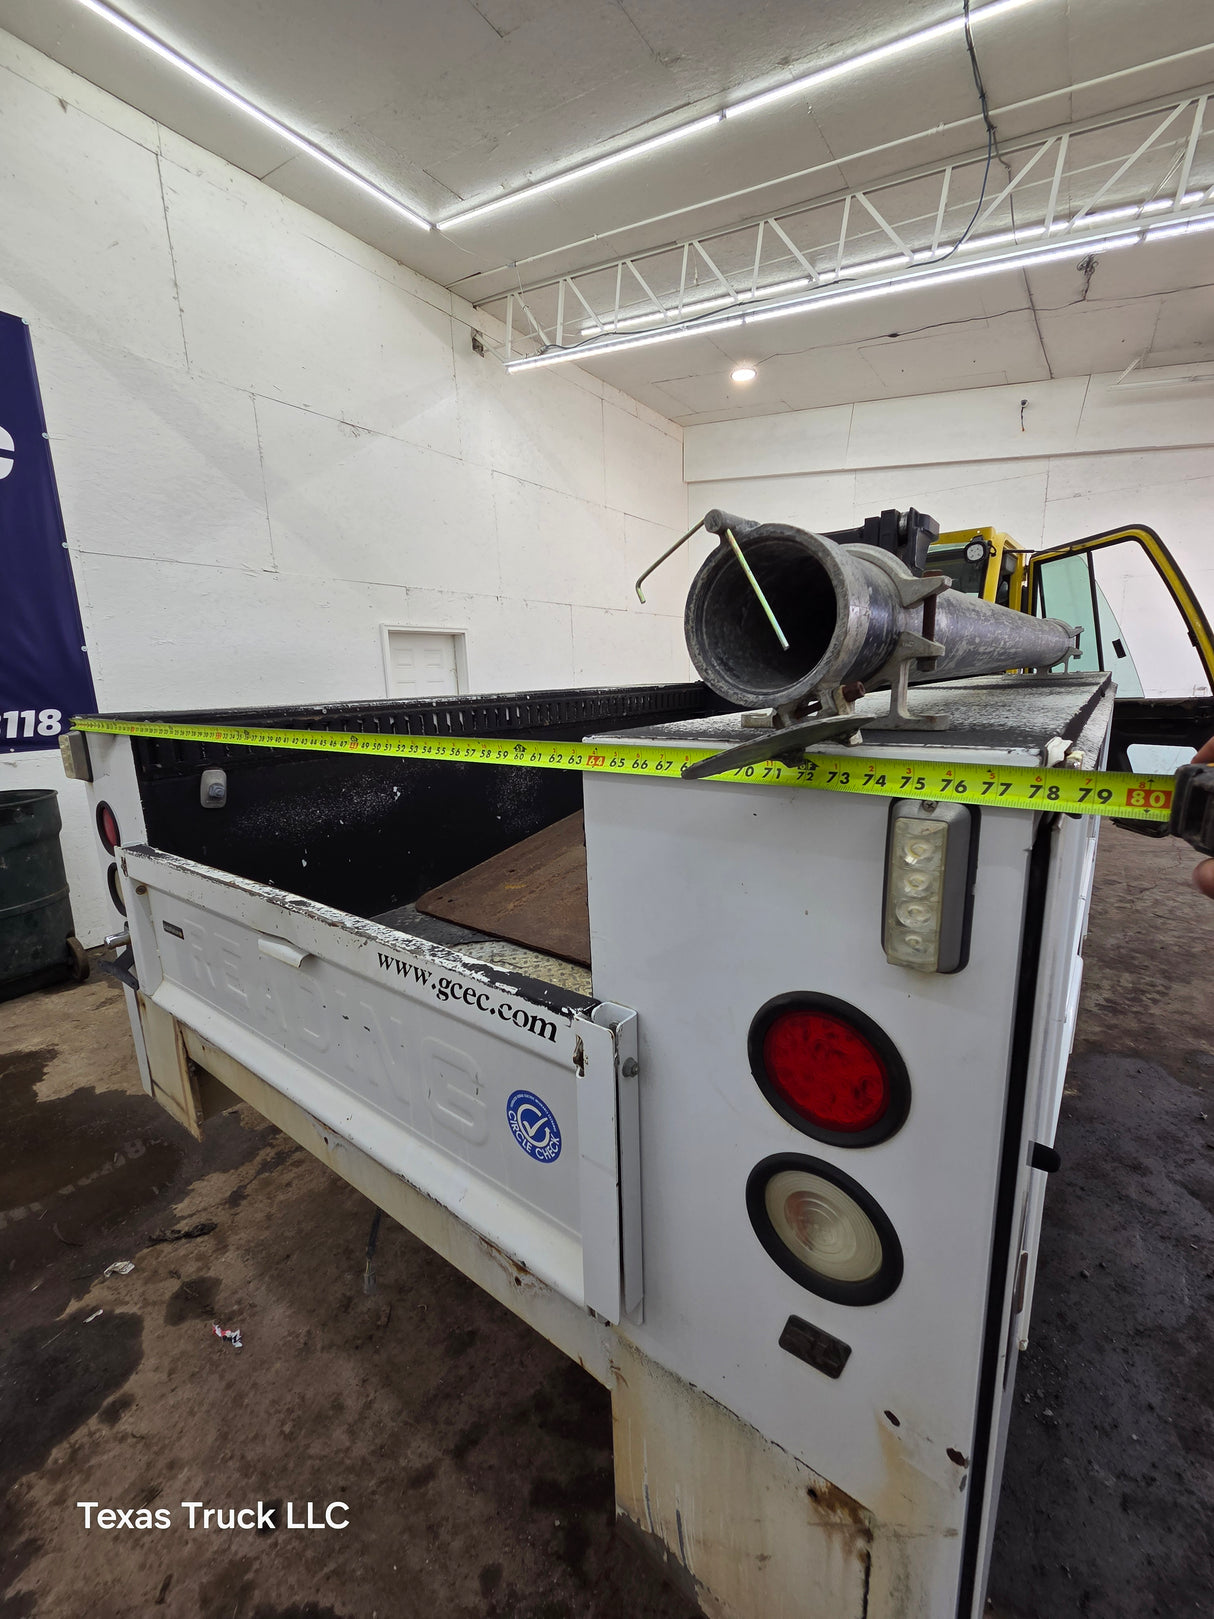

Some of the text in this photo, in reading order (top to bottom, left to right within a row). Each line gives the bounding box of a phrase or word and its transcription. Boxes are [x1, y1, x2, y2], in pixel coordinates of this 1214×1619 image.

[0, 708, 62, 738] 118
[396, 744, 406, 752] 52
[409, 744, 420, 753] 53
[422, 746, 432, 754] 54
[435, 746, 446, 755] 55
[450, 748, 461, 756] 56
[464, 748, 476, 757] 57
[480, 749, 492, 758] 58
[496, 750, 509, 760] 59
[530, 752, 542, 762] 61
[549, 754, 563, 763] 62
[568, 754, 583, 764] 63
[588, 757, 605, 766] 64
[610, 758, 626, 768] 65
[632, 758, 648, 770] 66
[655, 760, 674, 771] 67
[680, 762, 692, 771] 6
[762, 768, 782, 780] 71
[796, 771, 815, 782] 72
[826, 771, 850, 785] 73
[863, 774, 886, 788] 74
[900, 776, 926, 791] 75
[940, 778, 968, 794] 76
[981, 781, 1013, 797] 77
[1028, 785, 1061, 800] 78
[1077, 788, 1113, 805] 79
[1131, 790, 1165, 808] 80
[377, 952, 557, 1043] www.gcec.com
[508, 1110, 533, 1154] CIRCLE
[535, 1133, 560, 1160] CHECK
